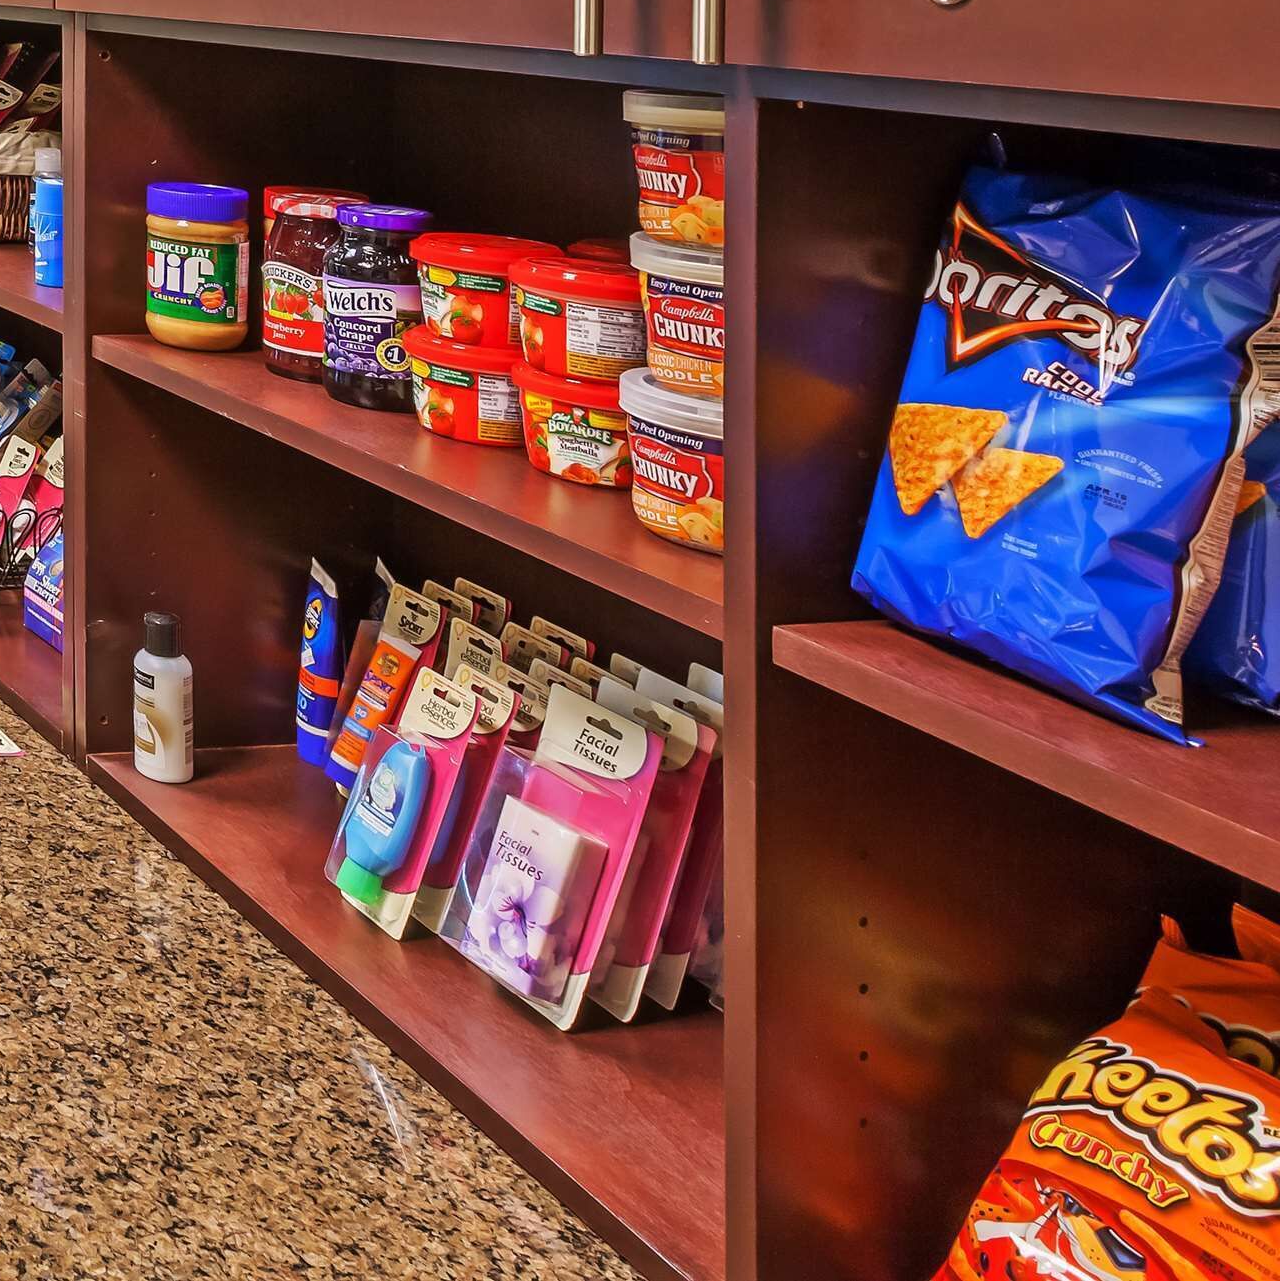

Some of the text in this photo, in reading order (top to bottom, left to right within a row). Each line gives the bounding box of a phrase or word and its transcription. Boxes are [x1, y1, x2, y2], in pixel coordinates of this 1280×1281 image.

[650, 134, 690, 147] Opening
[191, 247, 211, 258] FAT
[147, 251, 215, 294] Jif
[153, 292, 193, 305] CRUNCHY
[669, 282, 690, 294] Peel
[328, 290, 393, 312] Welch's
[272, 330, 286, 340] Jam
[333, 317, 381, 335] Concord
[338, 328, 375, 343] Grape
[345, 342, 367, 351] JELLY
[386, 347, 401, 363] #1
[548, 419, 612, 445] BOYARDEE
[557, 435, 600, 451] Spaghetti &
[640, 422, 657, 436] Peel
[657, 428, 703, 450] Opening
[560, 444, 598, 458] Meatballs
[1076, 449, 1164, 483] GUARANTEED FRESH
[33, 580, 60, 607] Energy
[40, 574, 62, 596] Sheer
[460, 652, 490, 674] essence
[420, 703, 459, 731] essences
[427, 697, 457, 720] Herbal
[578, 728, 620, 758] Facial
[572, 739, 618, 773] Tissues
[498, 830, 533, 856] Facial
[495, 842, 544, 882] Tissues
[1029, 1041, 1280, 1203] heetos
[1031, 1114, 1189, 1207] Crunchy
[1203, 1216, 1277, 1257] GUARANTEED
